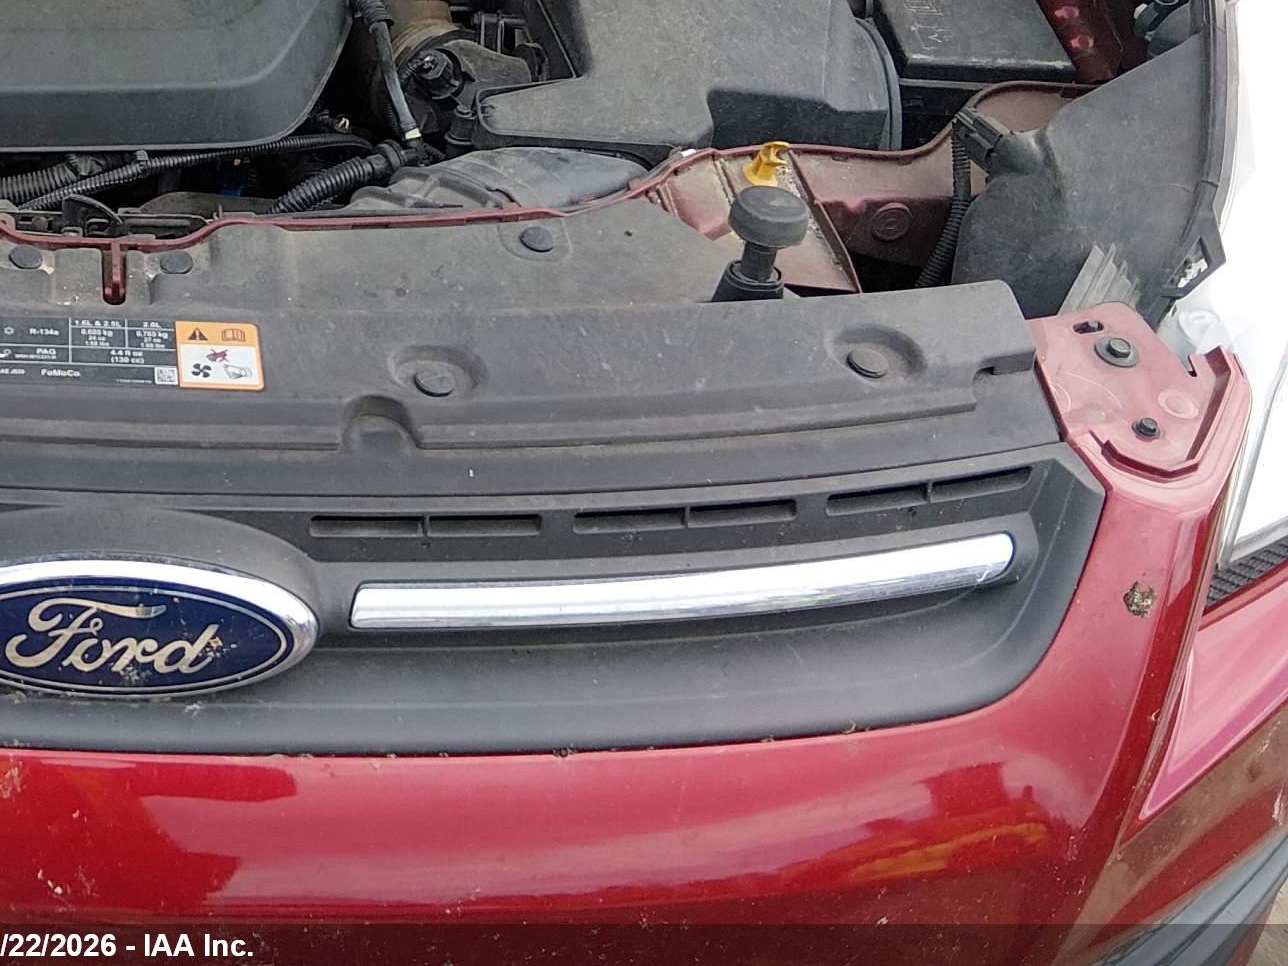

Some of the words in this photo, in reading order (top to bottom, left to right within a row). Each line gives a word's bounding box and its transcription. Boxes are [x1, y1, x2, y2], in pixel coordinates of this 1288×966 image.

[29, 327, 60, 336] R-134a
[40, 368, 81, 377] FoMoCo
[5, 597, 220, 675] Ford
